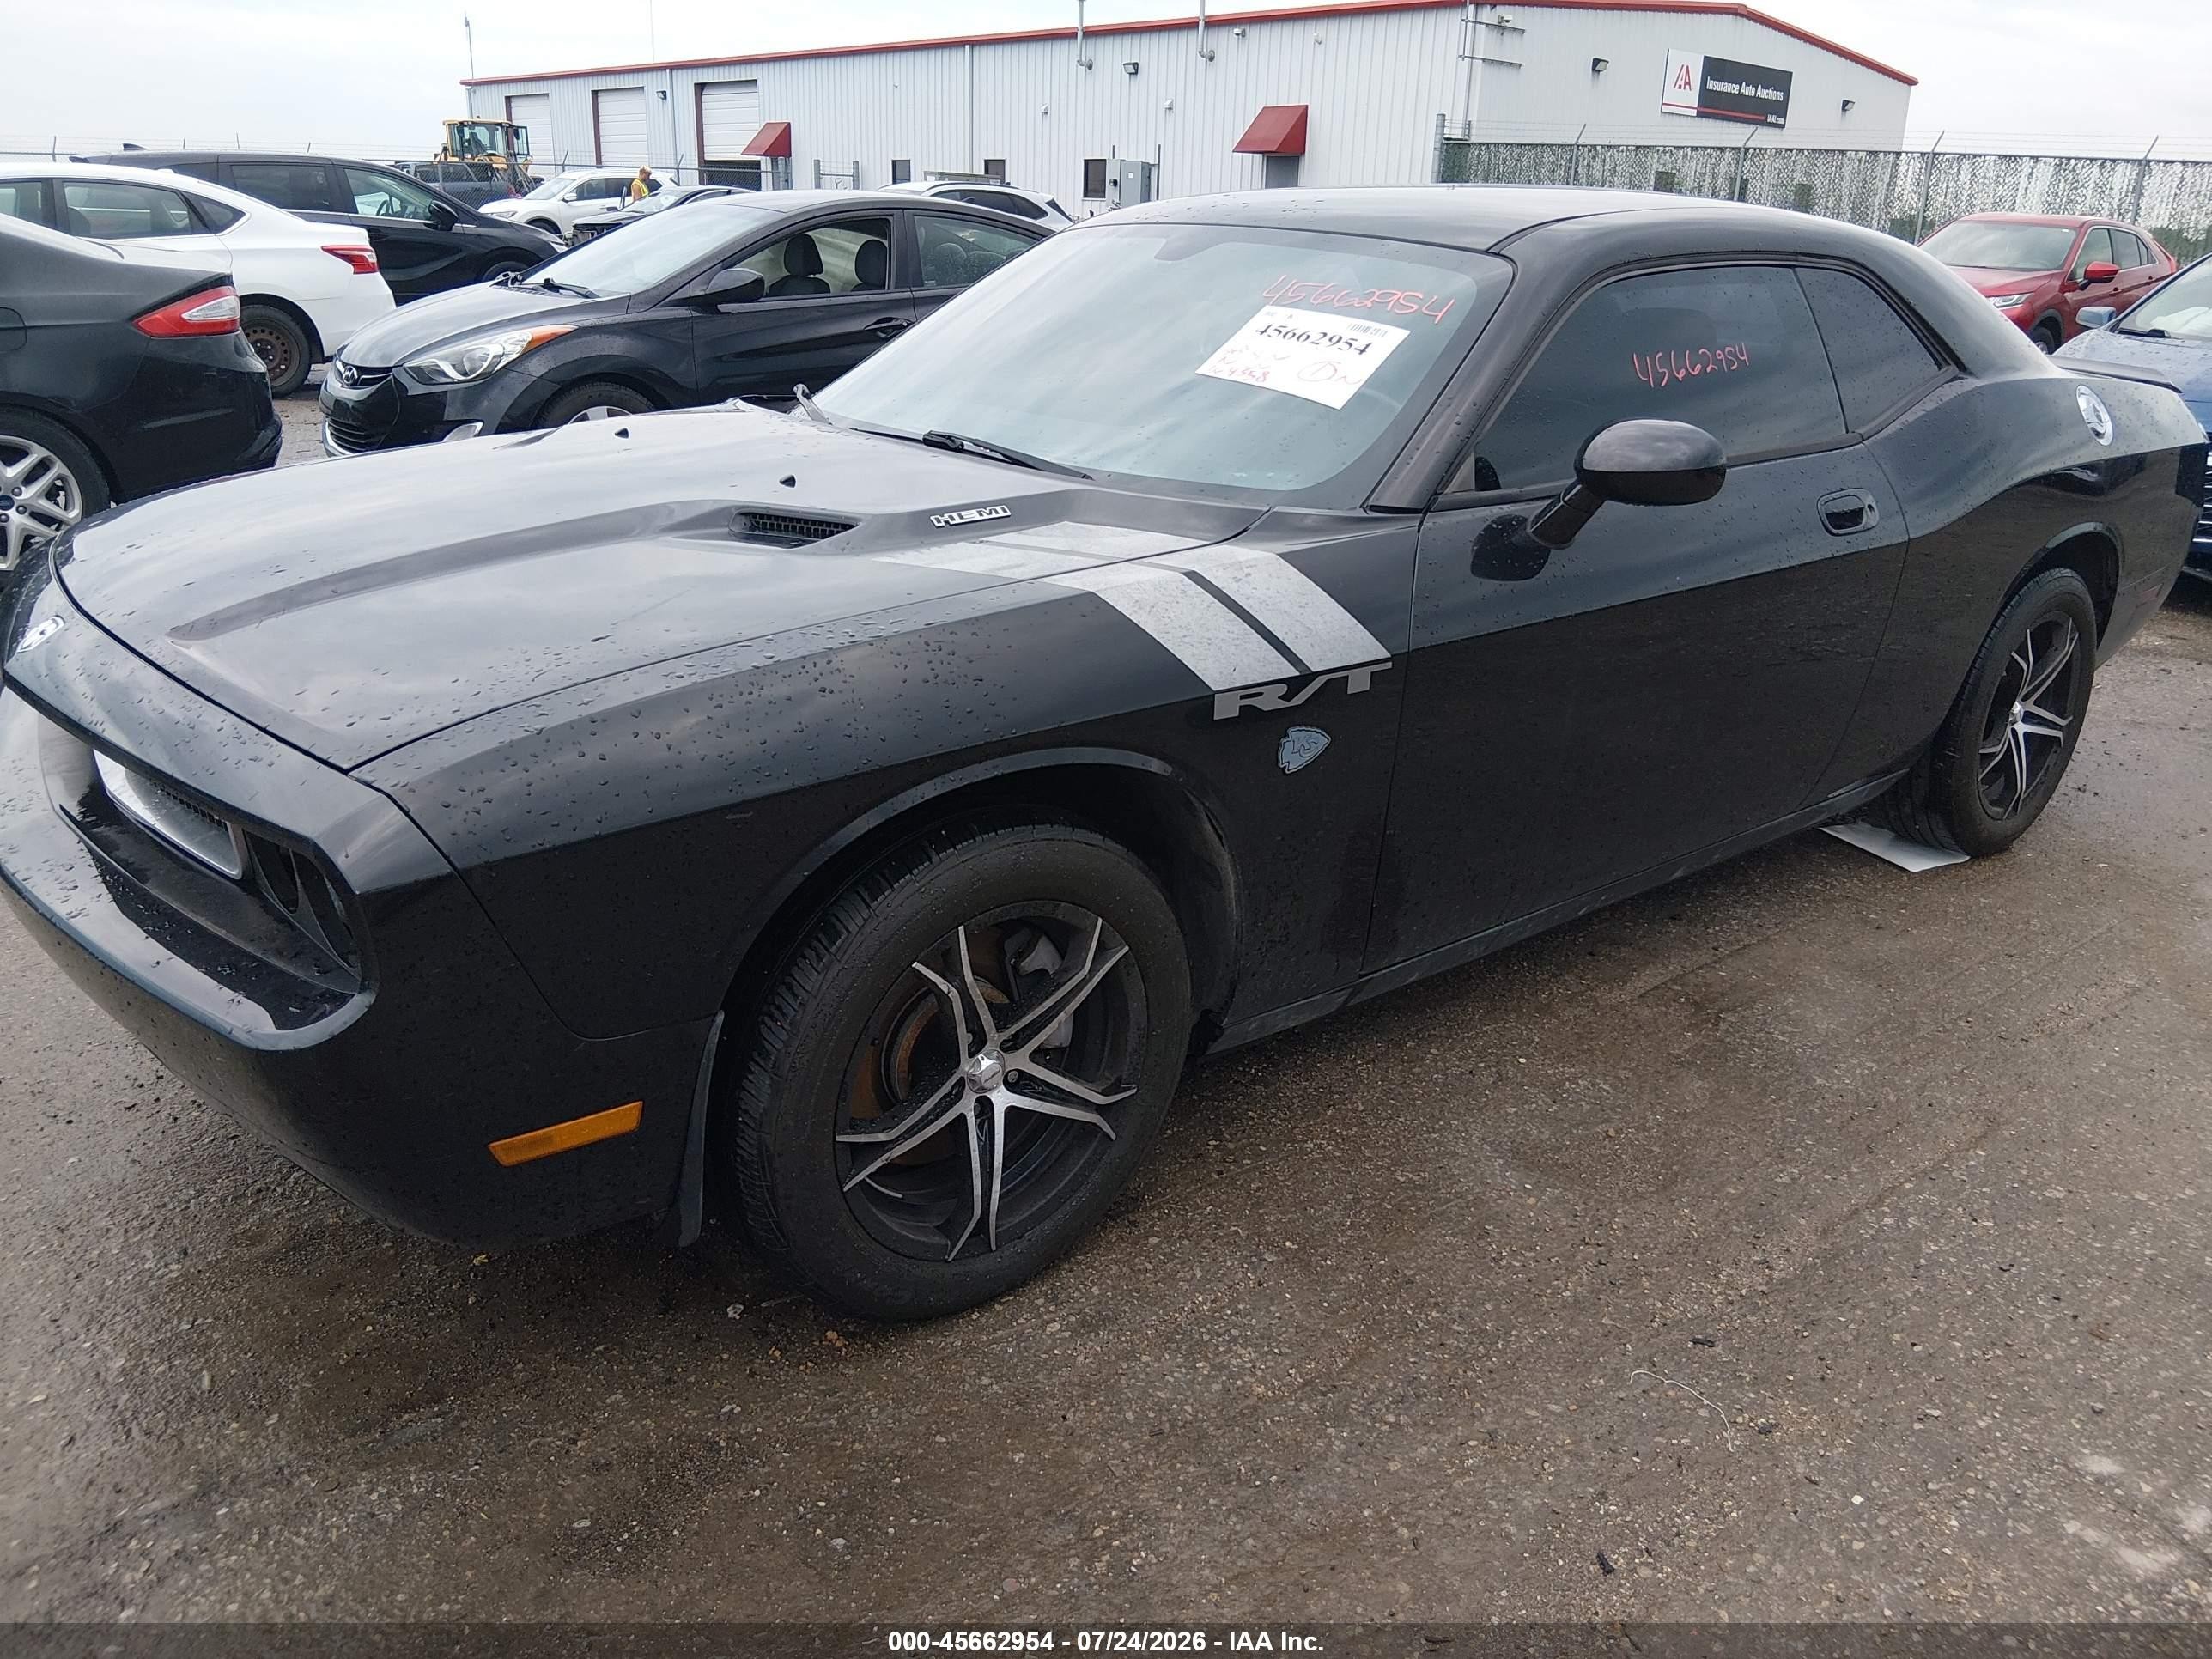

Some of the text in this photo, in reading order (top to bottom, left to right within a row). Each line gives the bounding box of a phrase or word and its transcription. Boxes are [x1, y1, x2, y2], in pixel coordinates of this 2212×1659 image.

[1706, 76, 1784, 101] Insurance Auto Auctions
[1262, 274, 1455, 325] 45662954
[1255, 323, 1374, 356] 45662954
[1633, 343, 1750, 388] 45662954
[929, 505, 1012, 528] HEMI
[1213, 660, 1393, 721] R/T
